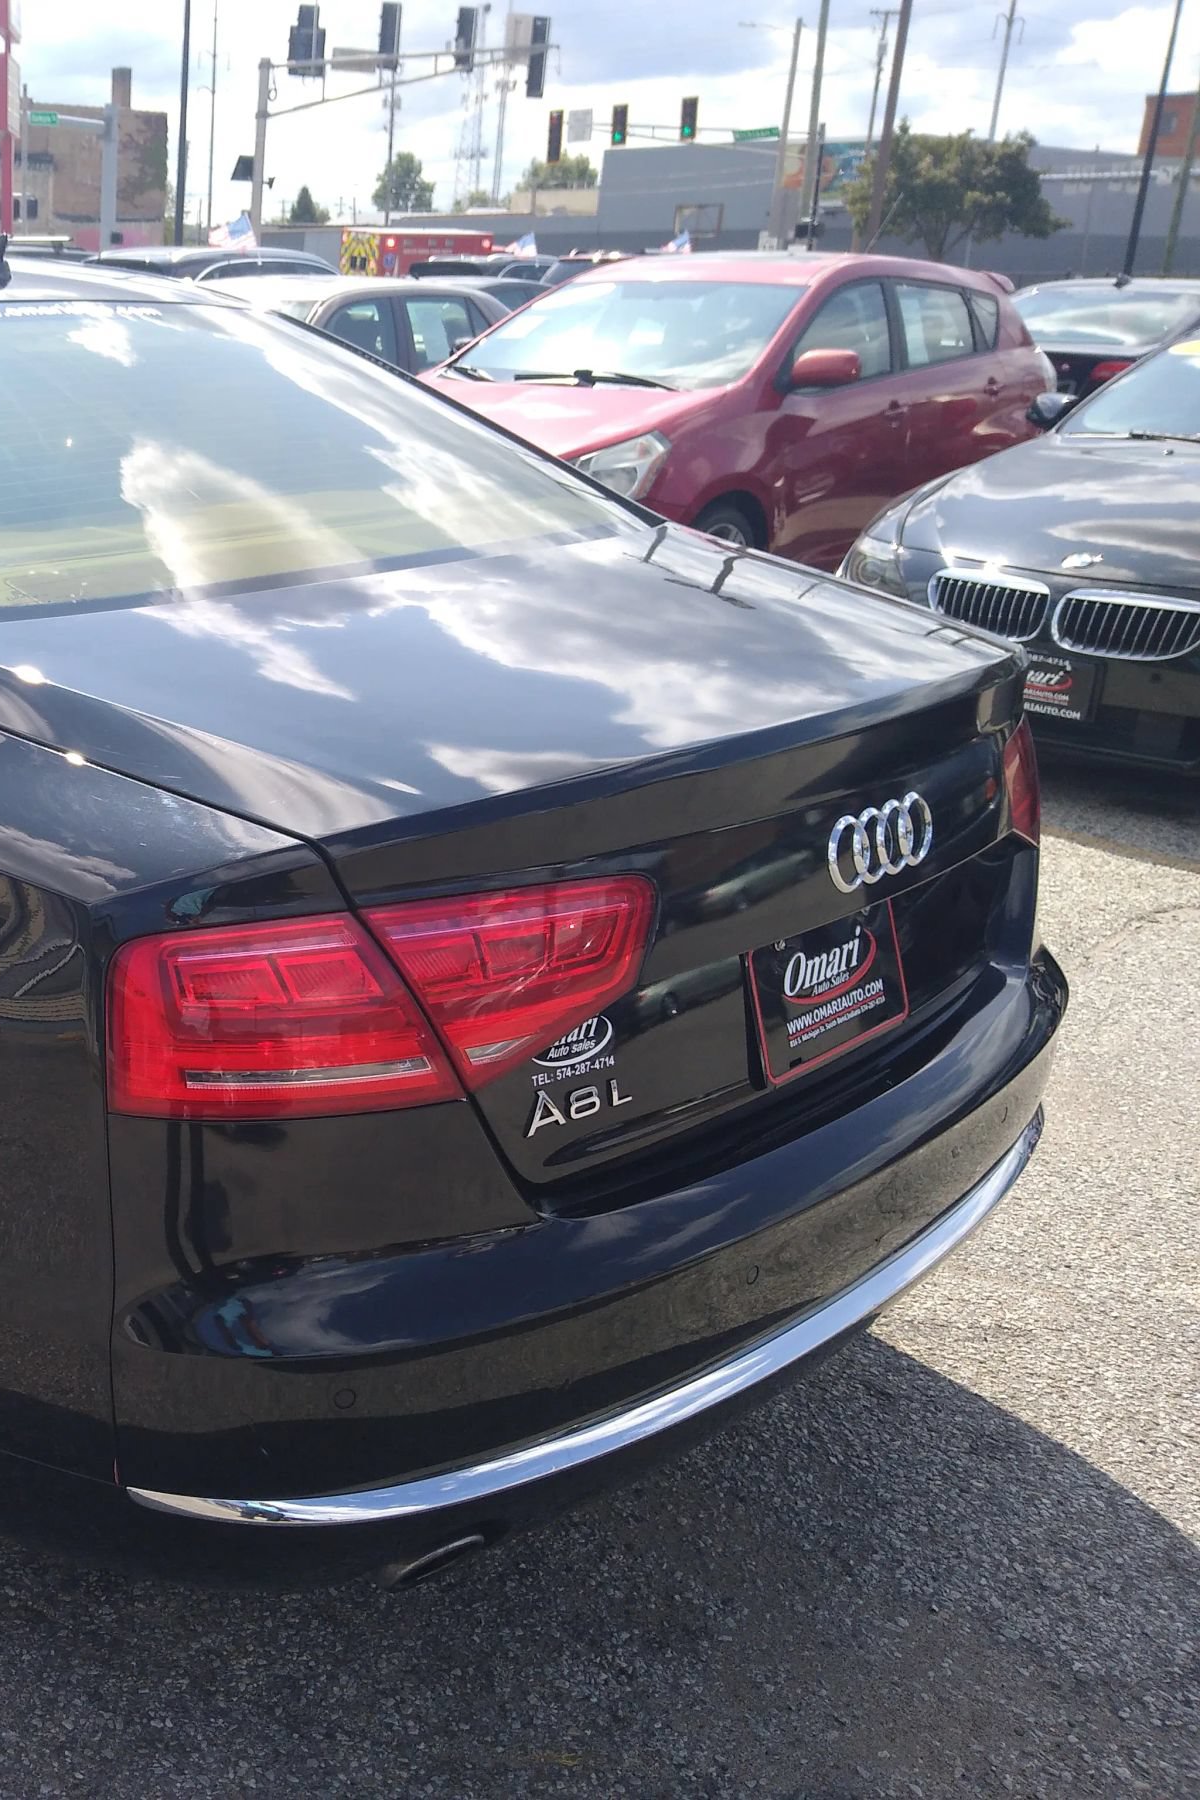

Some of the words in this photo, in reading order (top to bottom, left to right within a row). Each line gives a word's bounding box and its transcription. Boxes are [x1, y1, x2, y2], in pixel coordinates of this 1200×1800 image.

[1023, 701, 1081, 720] RIAUTO.COM
[784, 925, 861, 997] Omari
[811, 981, 830, 996] Auto
[831, 972, 850, 987] Sales
[786, 978, 884, 1035] WWW.OMARIAUTO.COM
[546, 1044, 570, 1060] Auto
[571, 1038, 597, 1053] sales
[531, 1072, 555, 1087] TEL:
[556, 1055, 615, 1080] 574-287-4714
[610, 1079, 633, 1107] L
